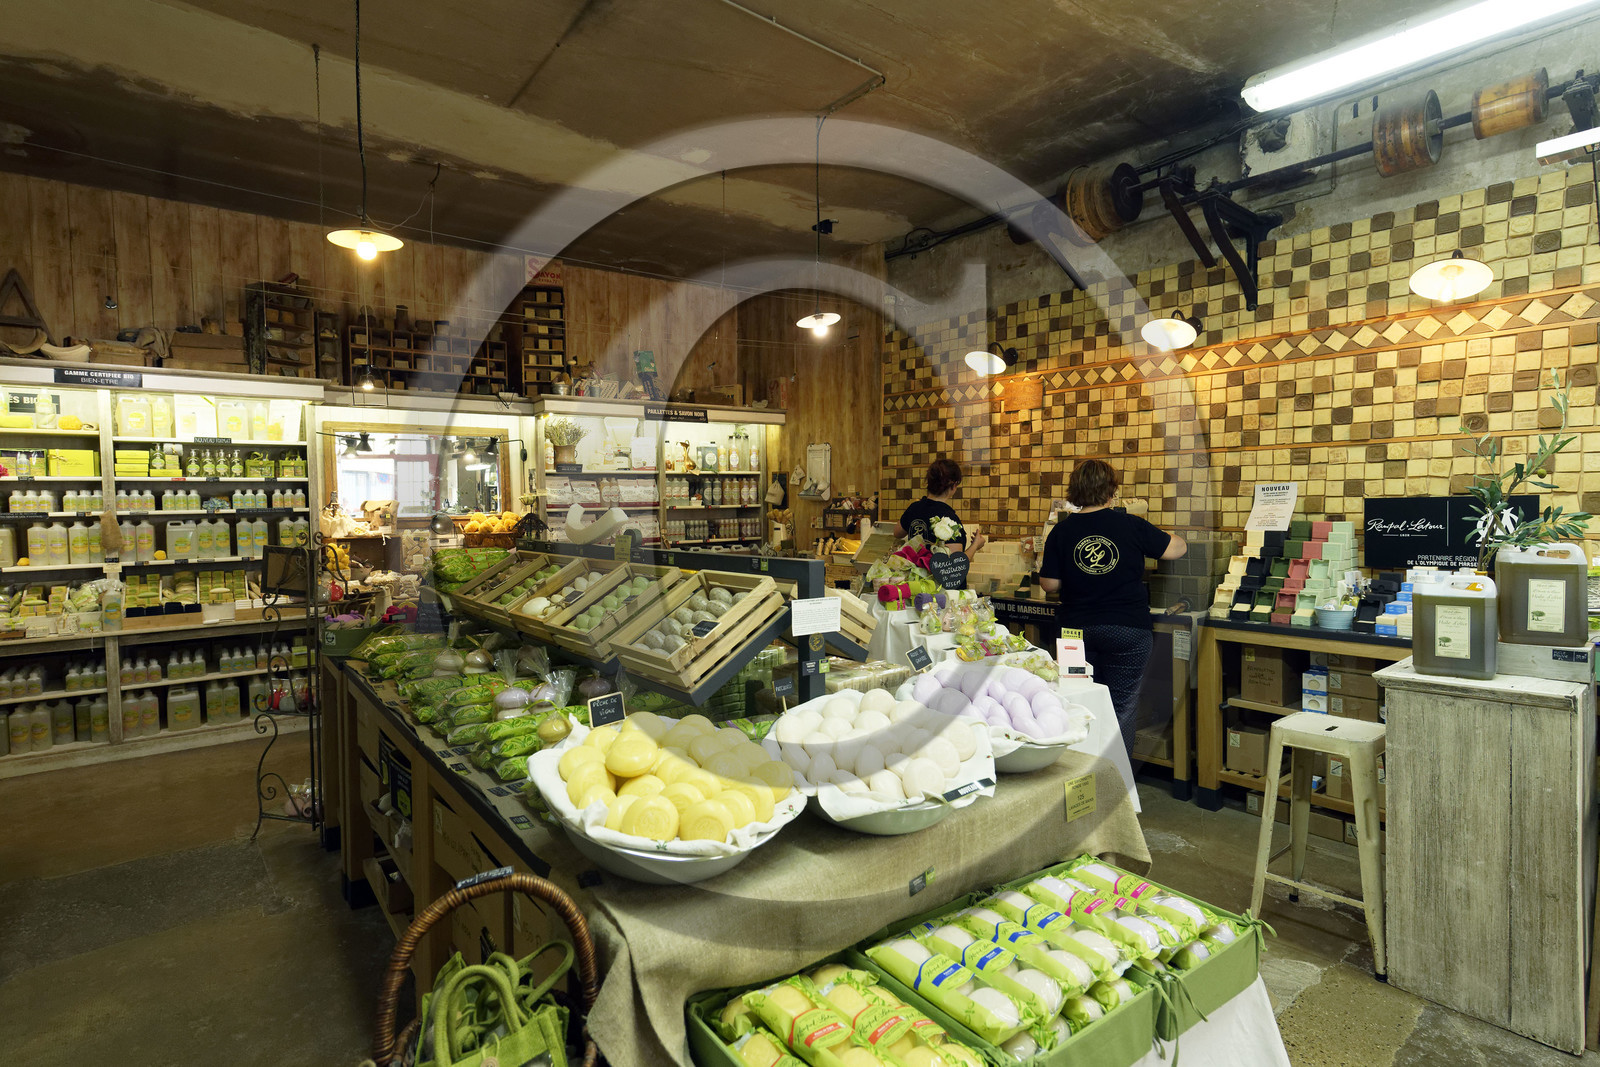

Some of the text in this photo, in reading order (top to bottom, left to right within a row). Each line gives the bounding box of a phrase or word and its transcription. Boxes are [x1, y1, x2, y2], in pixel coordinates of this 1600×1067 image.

[1366, 518, 1446, 533] Rampal Latour
[1417, 554, 1477, 562] PARTENAIRE RÉGION
[1007, 603, 1016, 612] DE
[1017, 604, 1056, 617] MARSEILLE
